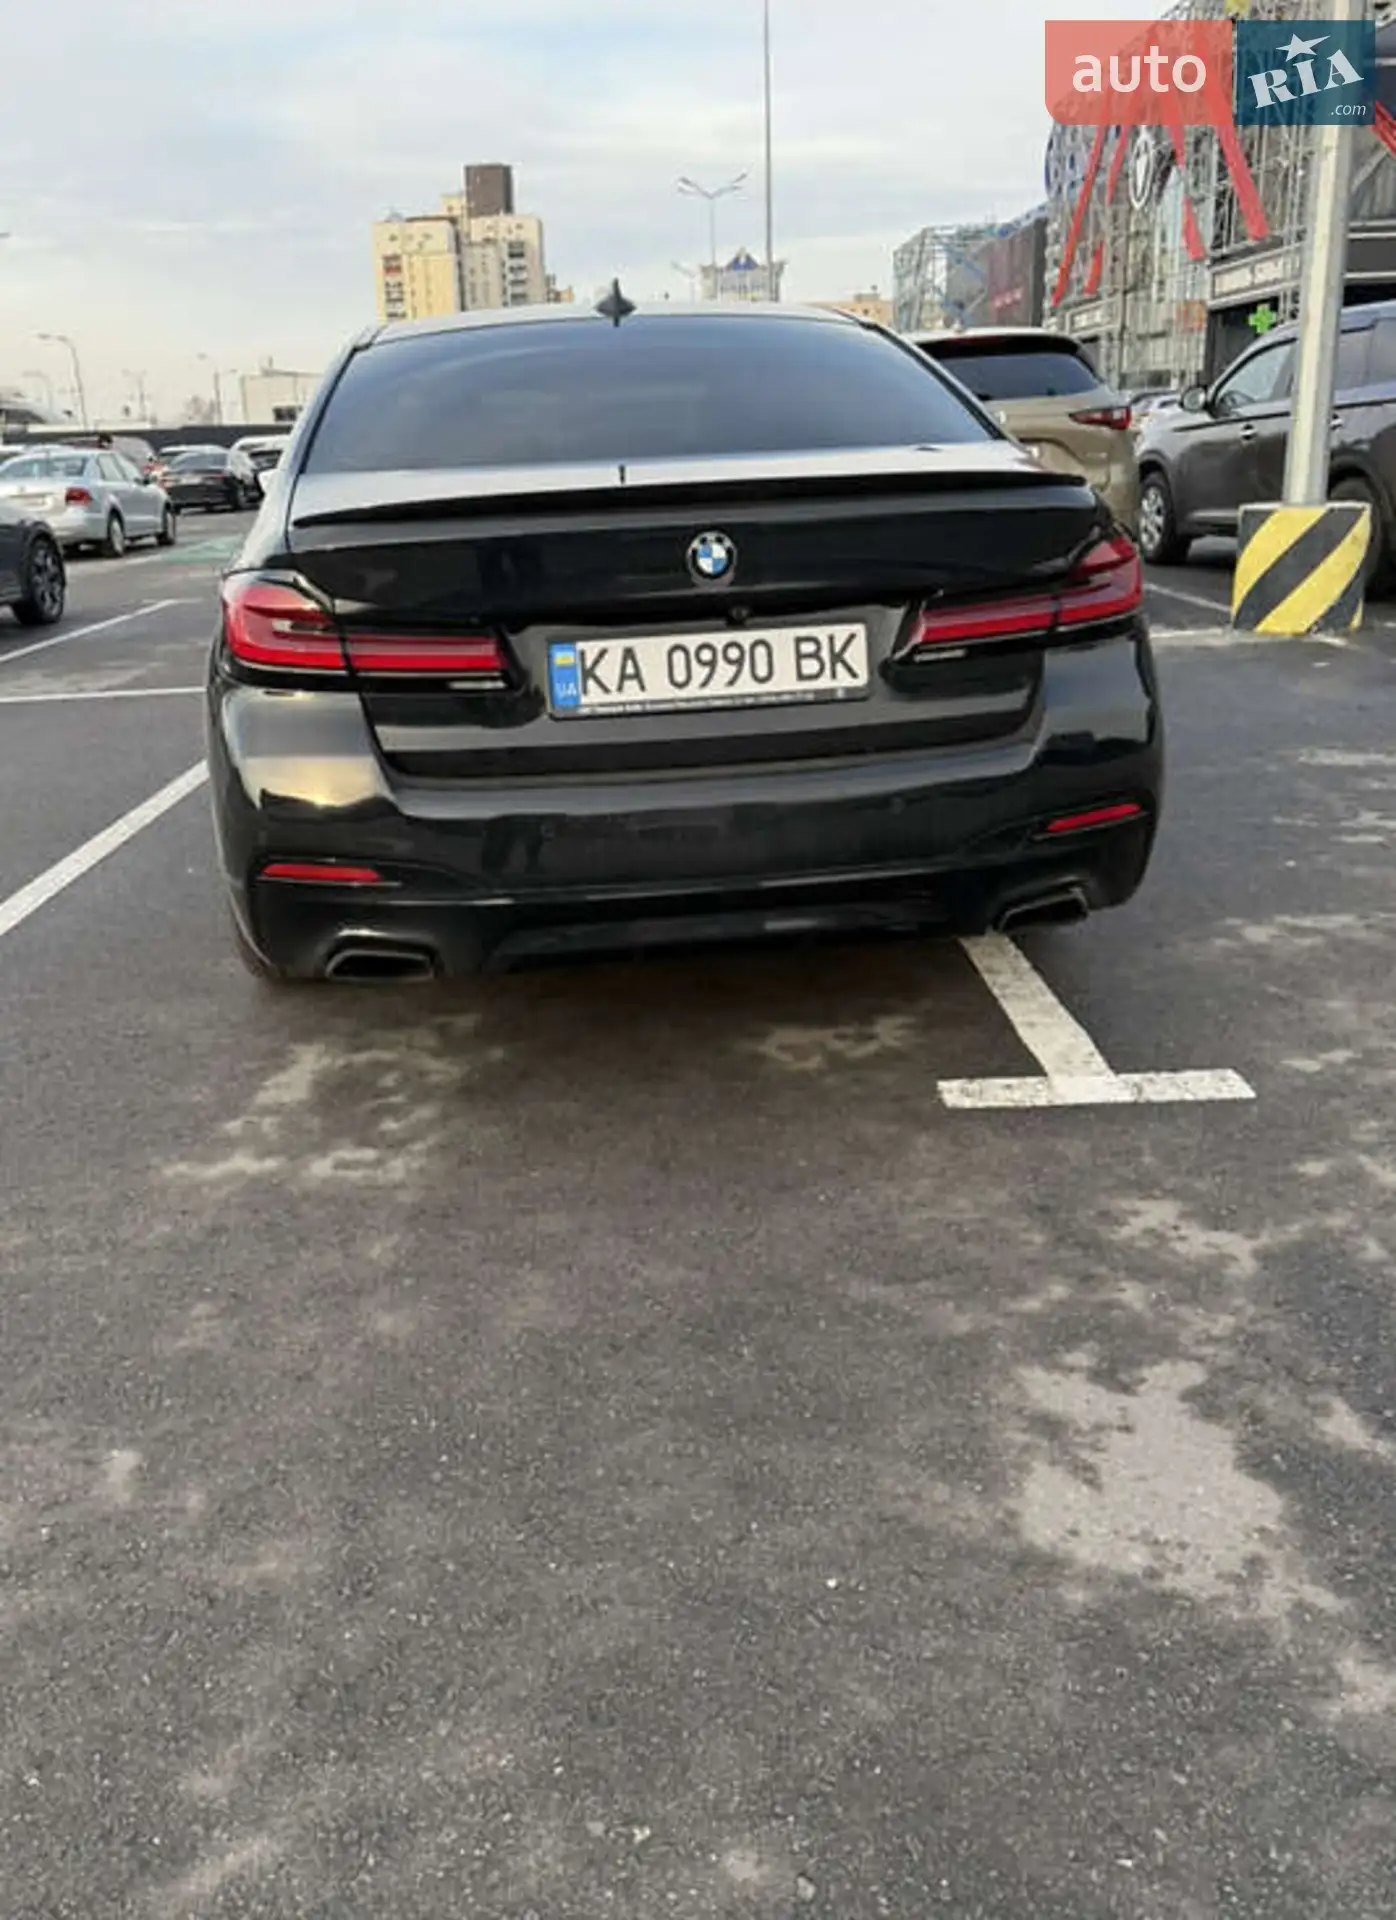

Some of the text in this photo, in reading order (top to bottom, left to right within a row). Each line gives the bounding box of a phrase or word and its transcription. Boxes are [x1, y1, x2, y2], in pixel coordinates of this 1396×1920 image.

[580, 633, 860, 696] KA 0990 BK
